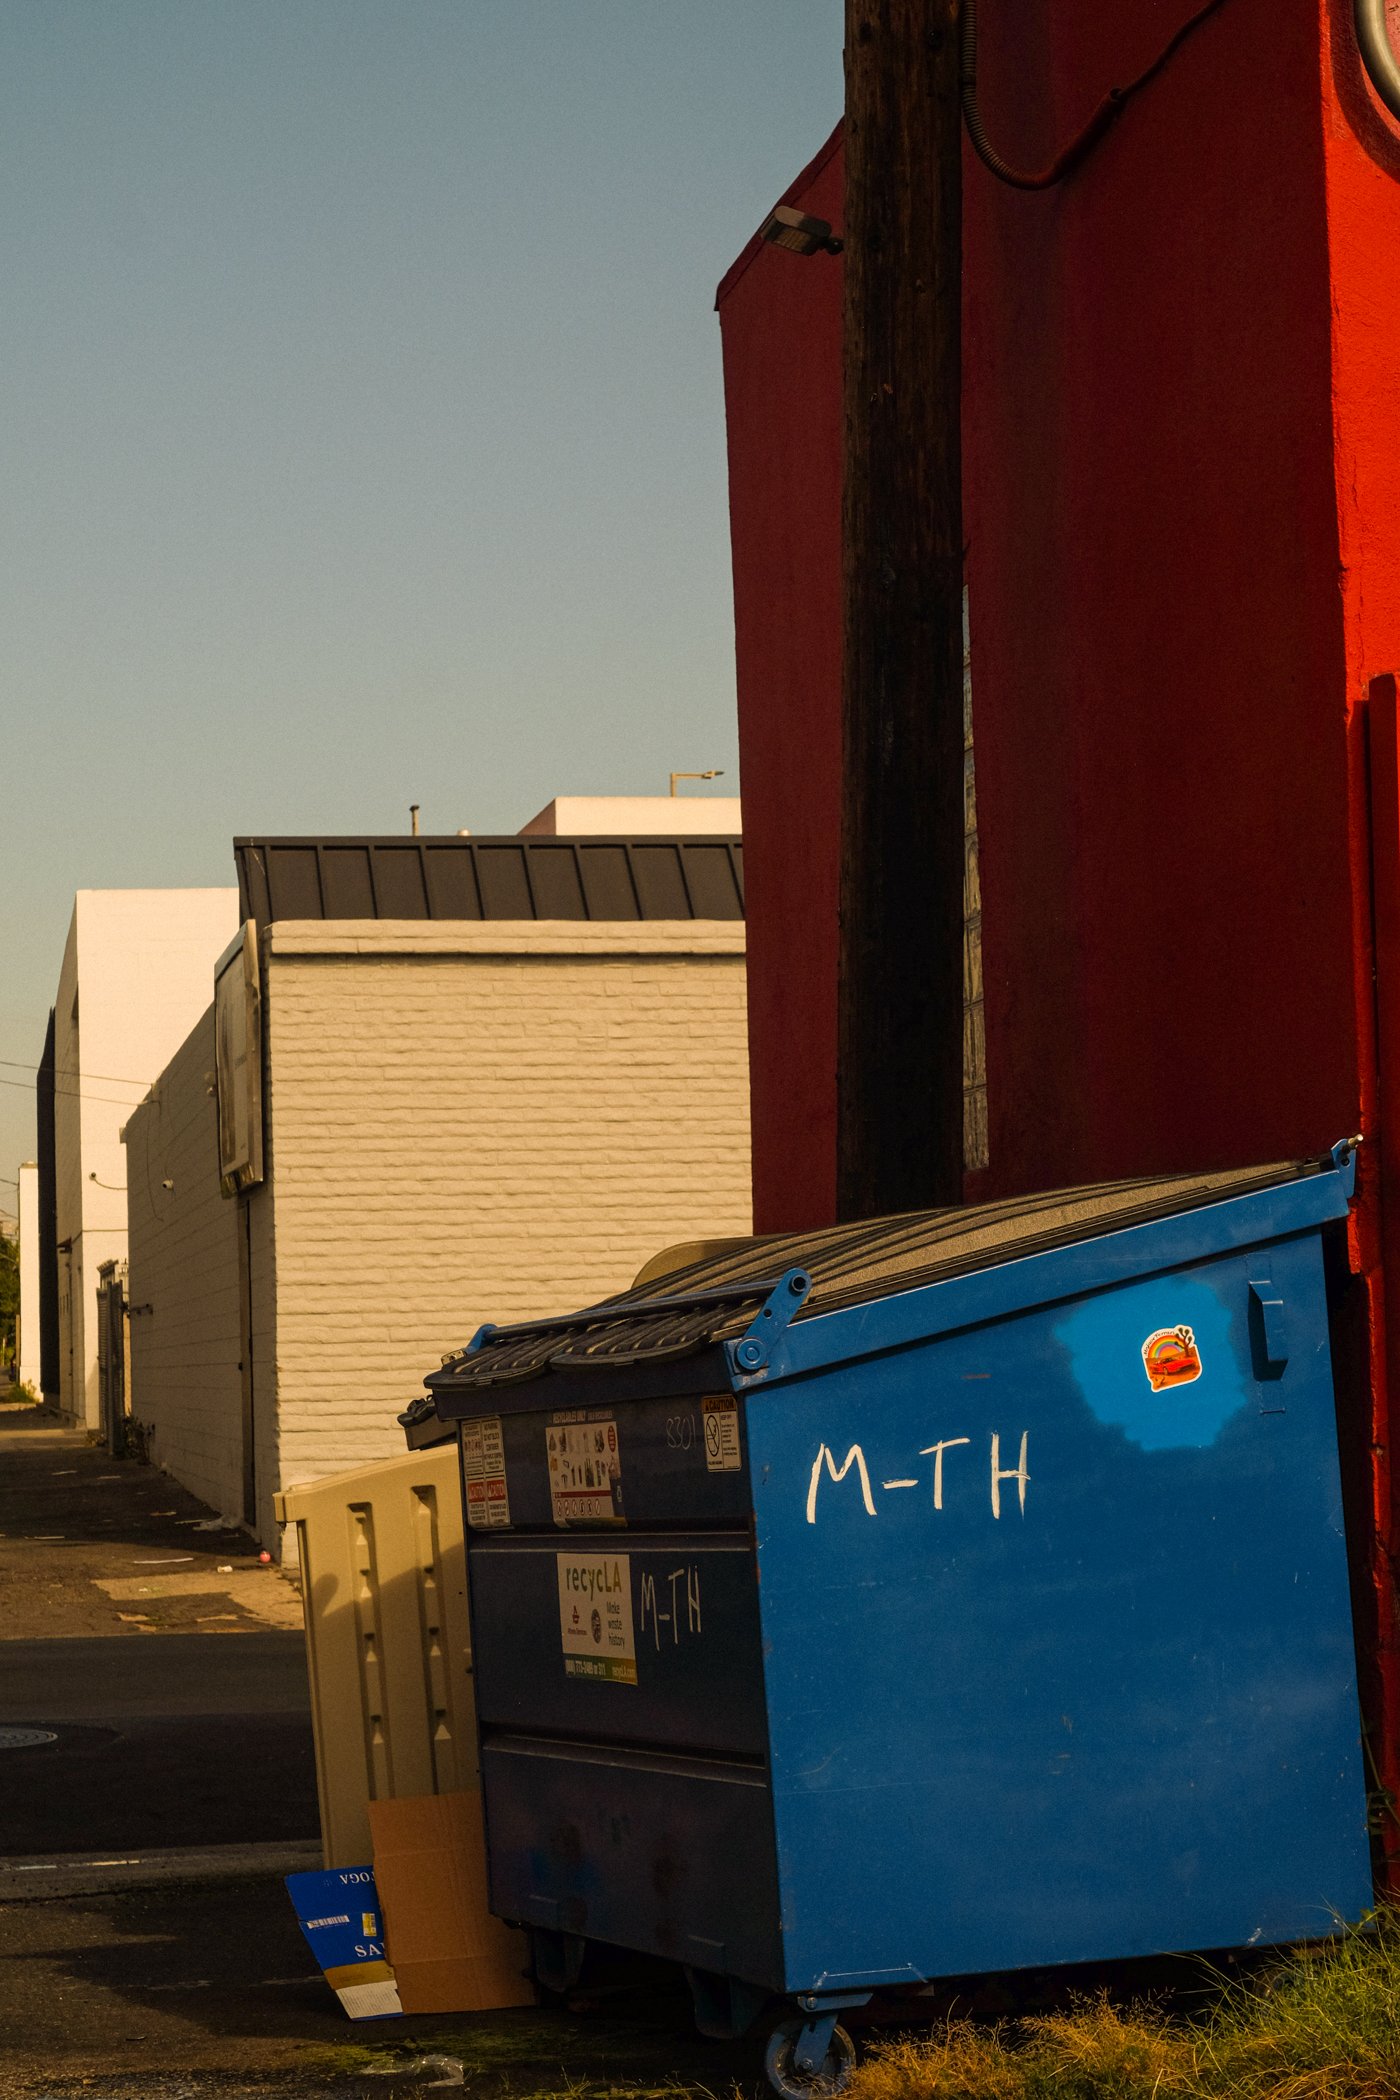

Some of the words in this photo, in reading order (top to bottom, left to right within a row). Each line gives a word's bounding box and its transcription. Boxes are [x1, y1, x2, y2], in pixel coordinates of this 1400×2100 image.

[709, 1398, 735, 1410] CAUTION
[806, 1431, 1031, 1524] M-TH
[566, 1561, 622, 1601] recycLA
[606, 1601, 620, 1614] Make
[640, 1564, 702, 1651] M-TH
[608, 1619, 622, 1630] waste
[608, 1633, 625, 1649] history
